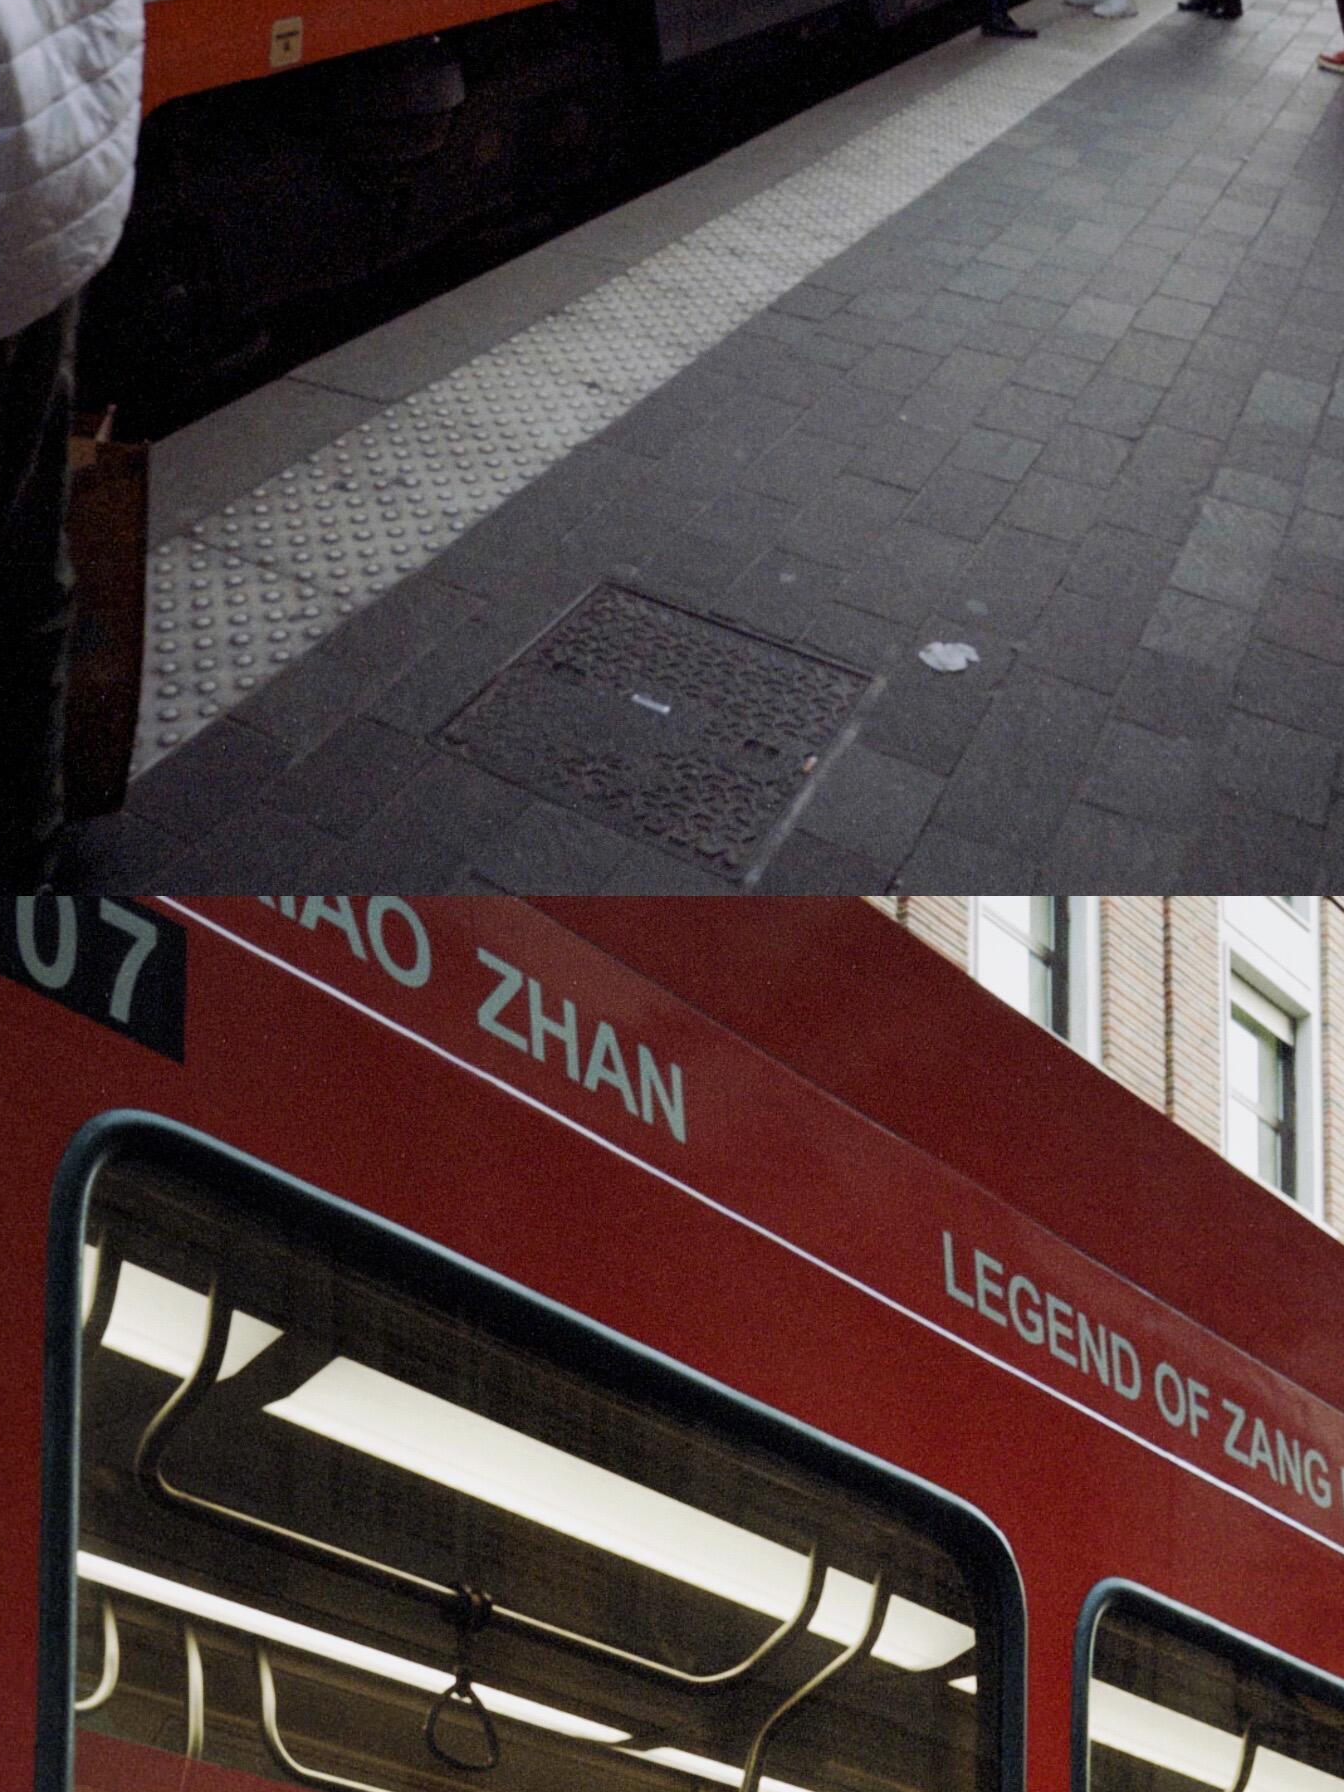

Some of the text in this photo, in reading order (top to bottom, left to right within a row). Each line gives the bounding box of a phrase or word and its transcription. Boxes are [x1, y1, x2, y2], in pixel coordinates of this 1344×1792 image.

[256, 896, 686, 1144] AO ZHAN
[942, 1230, 1142, 1401] LEGEND
[1154, 1361, 1210, 1438] OF
[1221, 1398, 1333, 1509] ZANG
